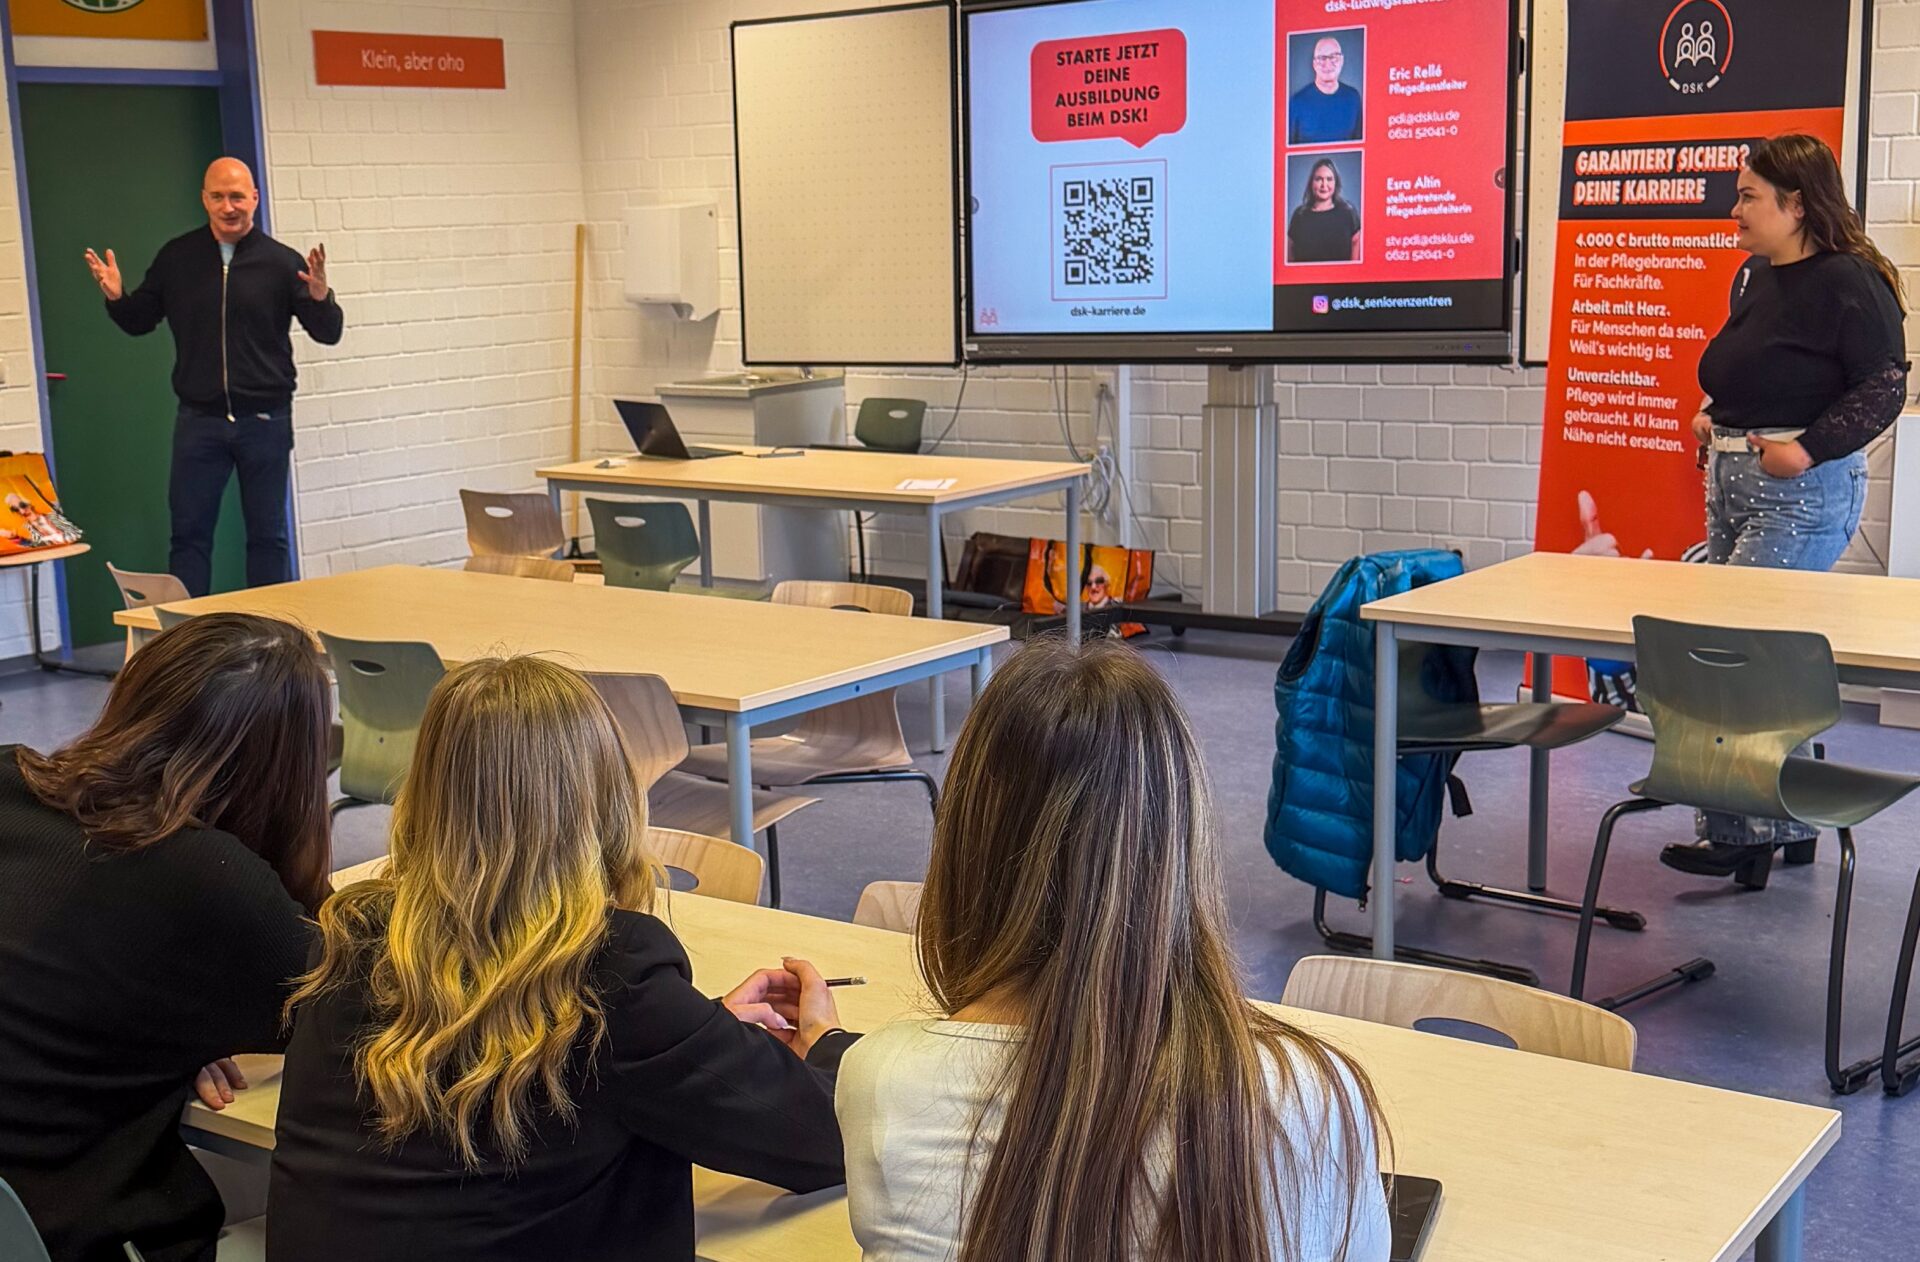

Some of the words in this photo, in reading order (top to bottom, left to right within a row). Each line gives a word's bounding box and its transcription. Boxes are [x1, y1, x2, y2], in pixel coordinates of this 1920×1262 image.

[361, 49, 400, 72] Klein,
[404, 51, 434, 71] aber
[438, 52, 465, 72] oho
[1057, 48, 1110, 66] STARTE
[1116, 43, 1159, 61] JETZT
[1084, 67, 1130, 84] DEINE
[1389, 67, 1411, 81] Eric
[1055, 85, 1160, 107] AUSBILDUNG
[1682, 82, 1704, 94] DSK
[1067, 112, 1105, 127] BEIM
[1110, 108, 1148, 125] DSK!
[1575, 147, 1676, 176] GARANTIERT
[1676, 144, 1750, 174] SICHER?
[1386, 178, 1411, 191] Esra
[1573, 179, 1621, 206] DEINE
[1622, 178, 1707, 205] KARRIERE
[1575, 232, 1614, 248] 4.000
[1616, 233, 1627, 248] €
[1628, 233, 1670, 248] brutto
[1574, 254, 1587, 268] In
[1588, 254, 1609, 269] der
[1611, 253, 1707, 272] Pflegebranche.
[1573, 273, 1592, 289] Für
[1594, 273, 1664, 290] Fachkräfte.
[1070, 305, 1146, 318] dsk-karriere.de
[1331, 294, 1453, 311] @dsk_seniorenzentren
[1571, 299, 1611, 316] Arbeit
[1612, 300, 1634, 316] mit
[1636, 301, 1671, 317] Herz.
[1570, 319, 1591, 335] Für
[1592, 320, 1656, 337] Menschen
[1658, 324, 1674, 338] da
[1676, 325, 1707, 340] sein.
[1607, 341, 1653, 361] wichtig
[1655, 345, 1673, 359] ist.
[1567, 366, 1660, 387] Unverzichtbar.
[1565, 387, 1606, 407] Pflege
[1607, 390, 1636, 406] wird
[1637, 391, 1679, 409] immer
[1564, 408, 1631, 426] gebraucht.
[1633, 413, 1647, 427] KI
[1648, 414, 1680, 431] kann
[1563, 427, 1595, 443] Nähe
[1596, 428, 1627, 446] nicht
[1629, 436, 1685, 452] ersetzen.
